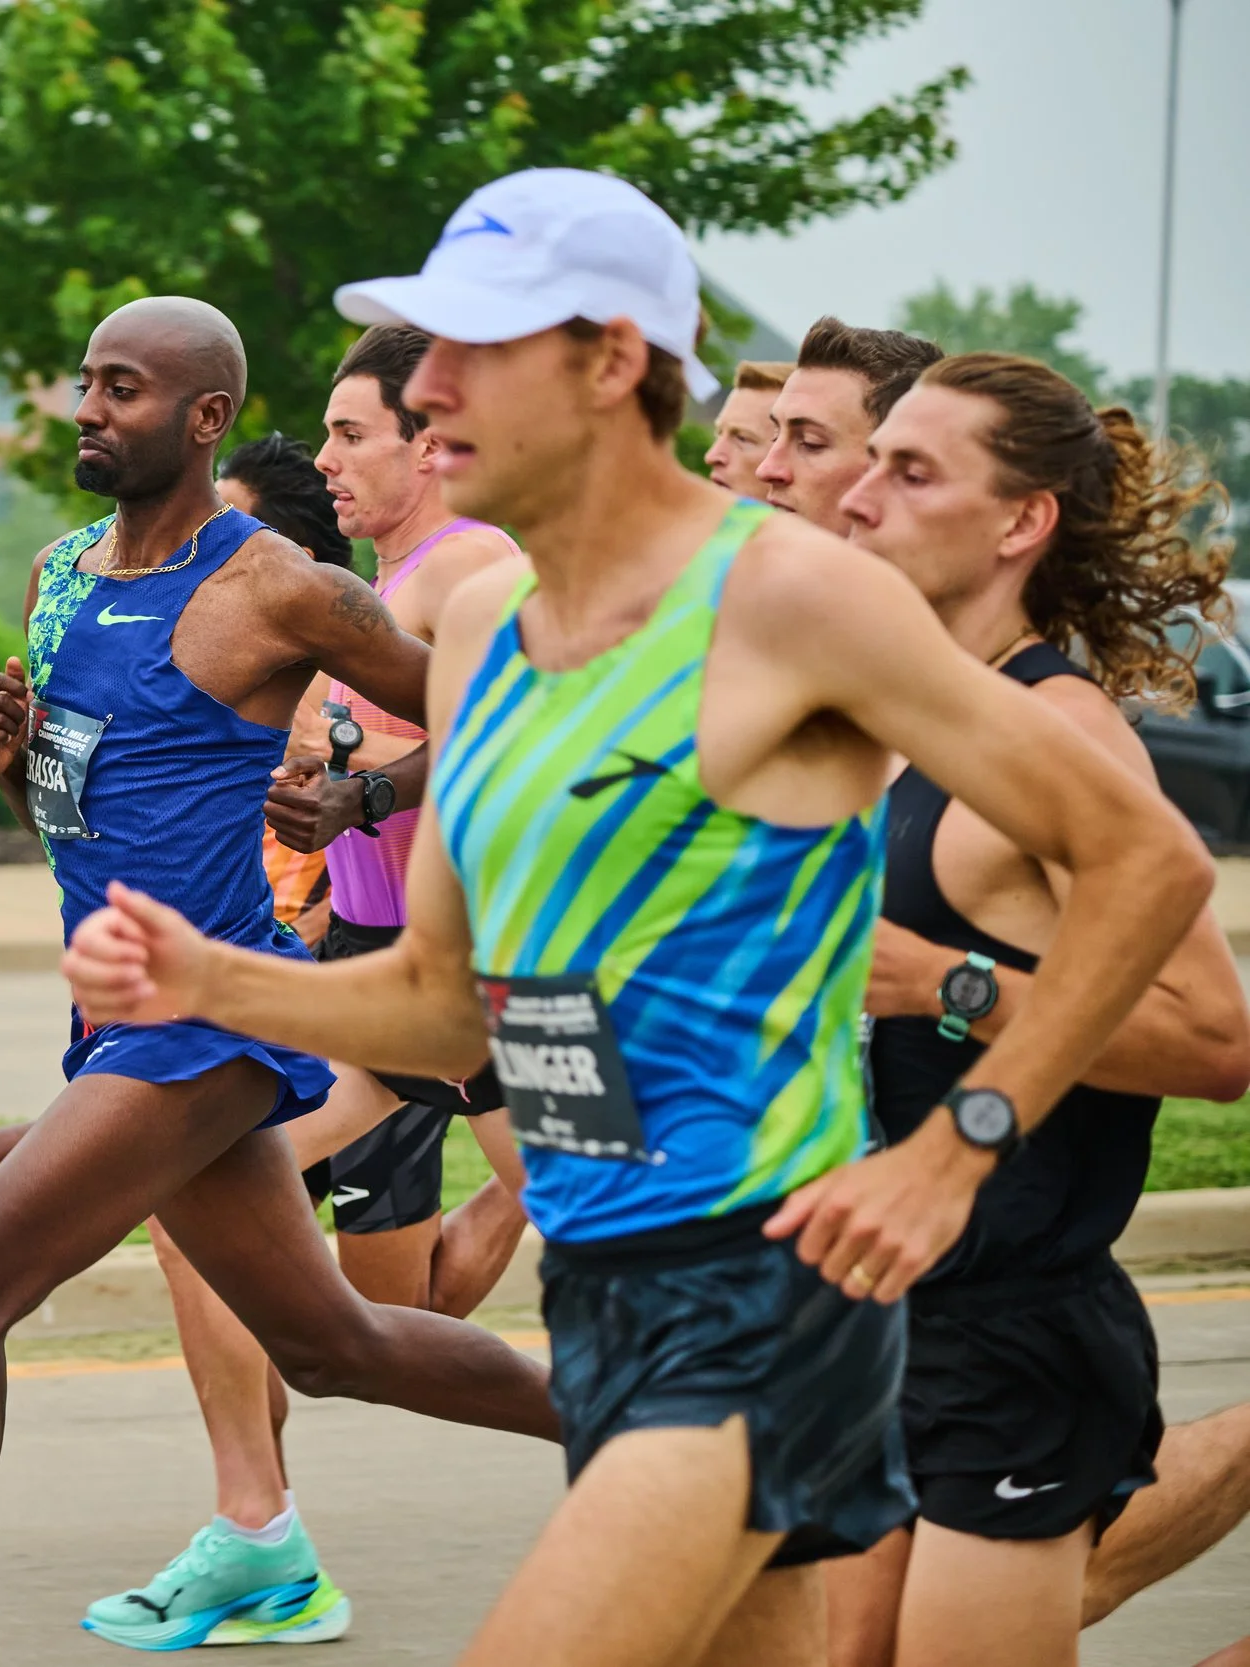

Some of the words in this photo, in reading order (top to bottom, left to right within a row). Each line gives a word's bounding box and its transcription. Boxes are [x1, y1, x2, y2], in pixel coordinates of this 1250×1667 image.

[38, 729, 87, 752] CHAMPIONSHIPS
[42, 720, 63, 734] USATF
[60, 727, 68, 735] 4
[67, 729, 92, 743] MILE
